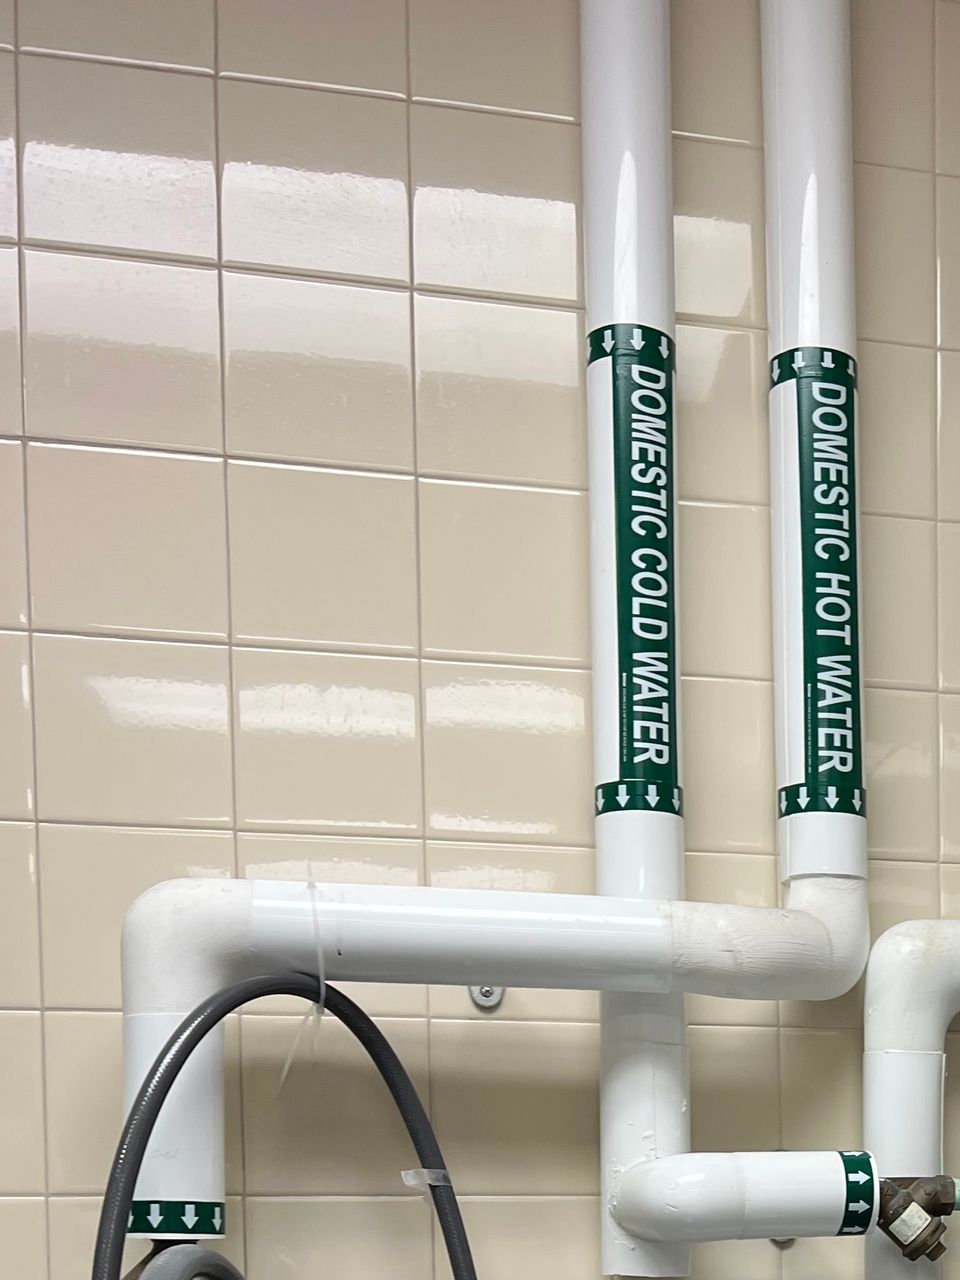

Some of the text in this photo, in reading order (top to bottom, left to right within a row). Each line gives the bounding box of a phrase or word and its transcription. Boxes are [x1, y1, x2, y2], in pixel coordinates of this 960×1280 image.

[630, 364, 670, 765] DOMESTIC COLD WATER
[812, 382, 854, 773] DOMESTIC HOT WATER
